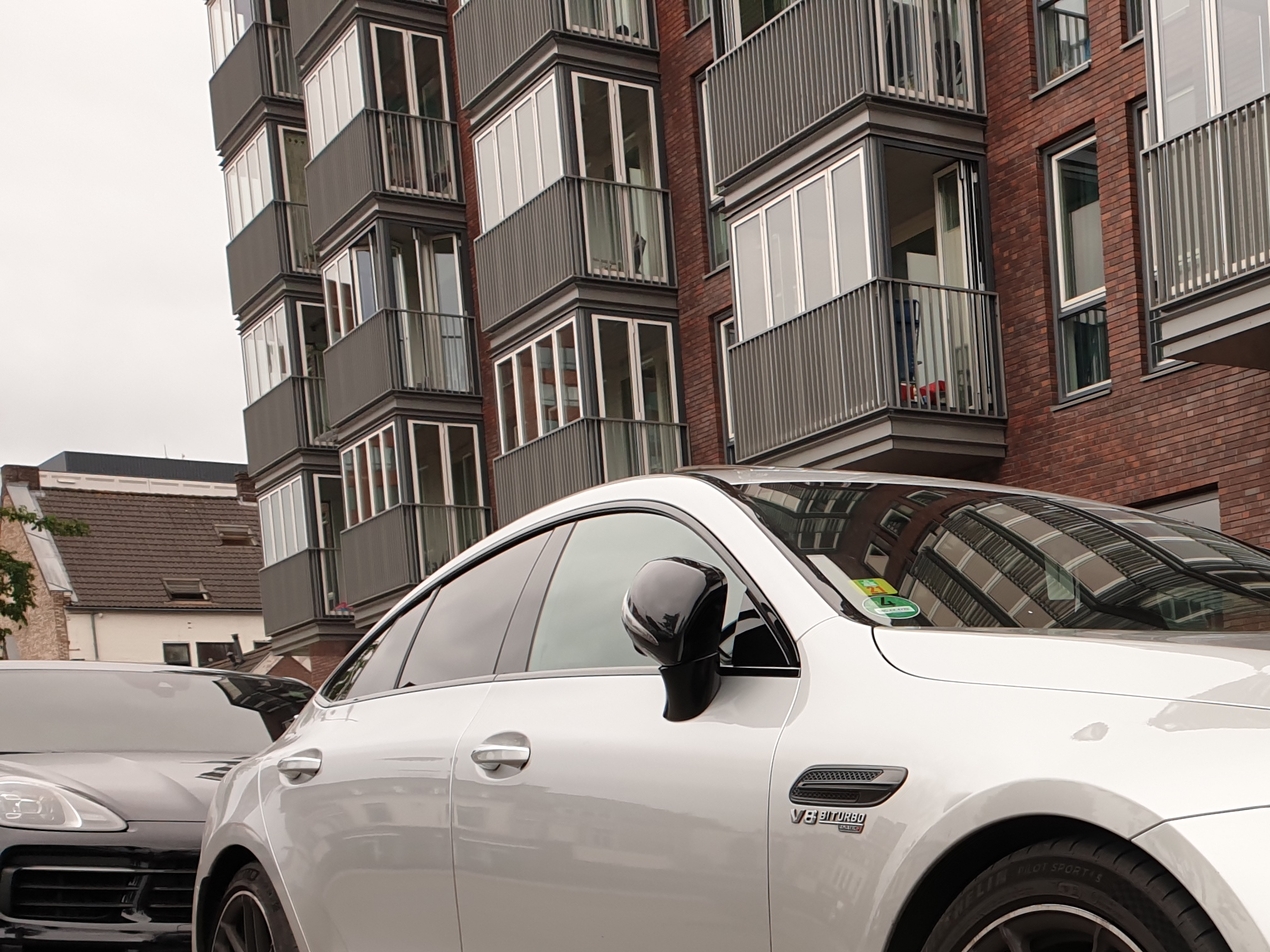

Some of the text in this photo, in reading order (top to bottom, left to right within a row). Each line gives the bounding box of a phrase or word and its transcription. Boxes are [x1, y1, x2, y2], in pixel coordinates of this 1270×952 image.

[791, 808, 867, 825] V8 BITURBO
[1050, 863, 1089, 877] SPORT
